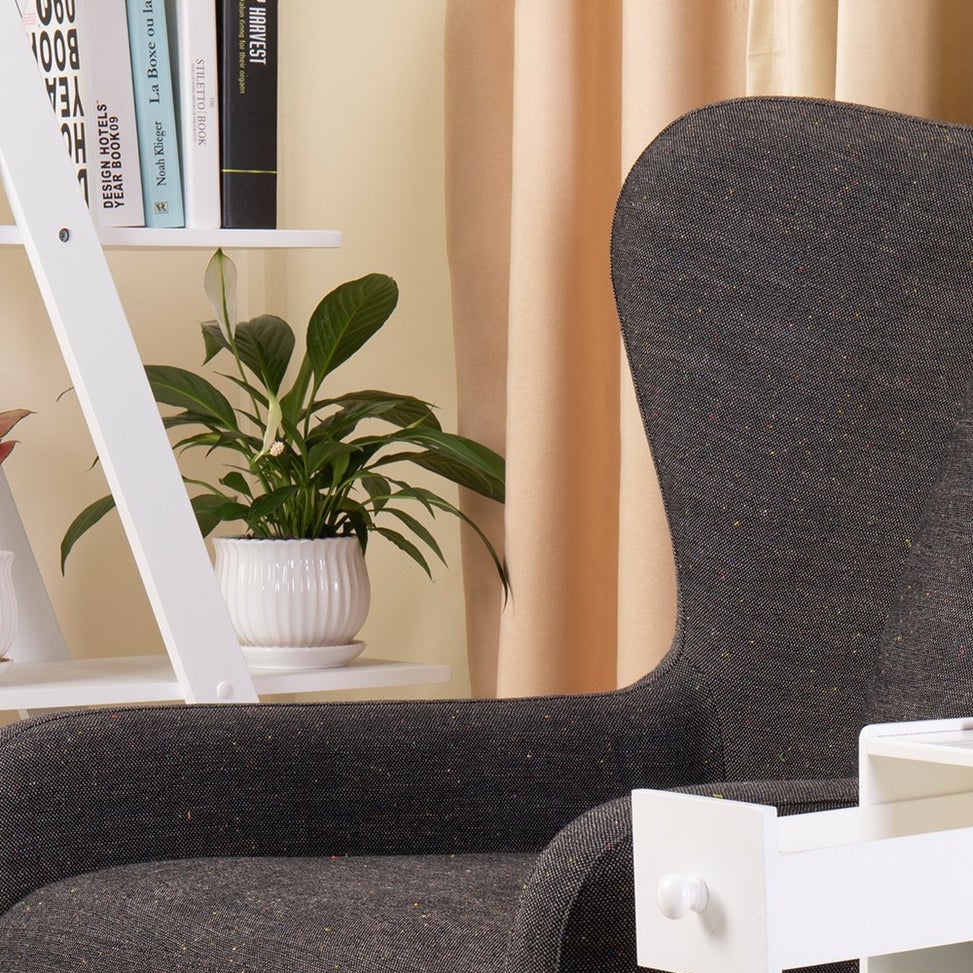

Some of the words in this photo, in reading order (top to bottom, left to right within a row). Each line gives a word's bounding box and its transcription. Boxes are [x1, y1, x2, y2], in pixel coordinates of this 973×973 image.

[147, 18, 155, 37] ou
[249, 7, 267, 65] HARVEST
[147, 41, 158, 79] Boxe
[149, 84, 160, 104] La
[196, 59, 206, 111] STILETTO
[97, 104, 110, 155] HOTELS
[154, 121, 166, 156] Klieger
[197, 116, 207, 146] BOOK
[101, 160, 114, 209] DESIGN
[156, 158, 168, 187] Noah
[112, 174, 125, 209] YEAR
